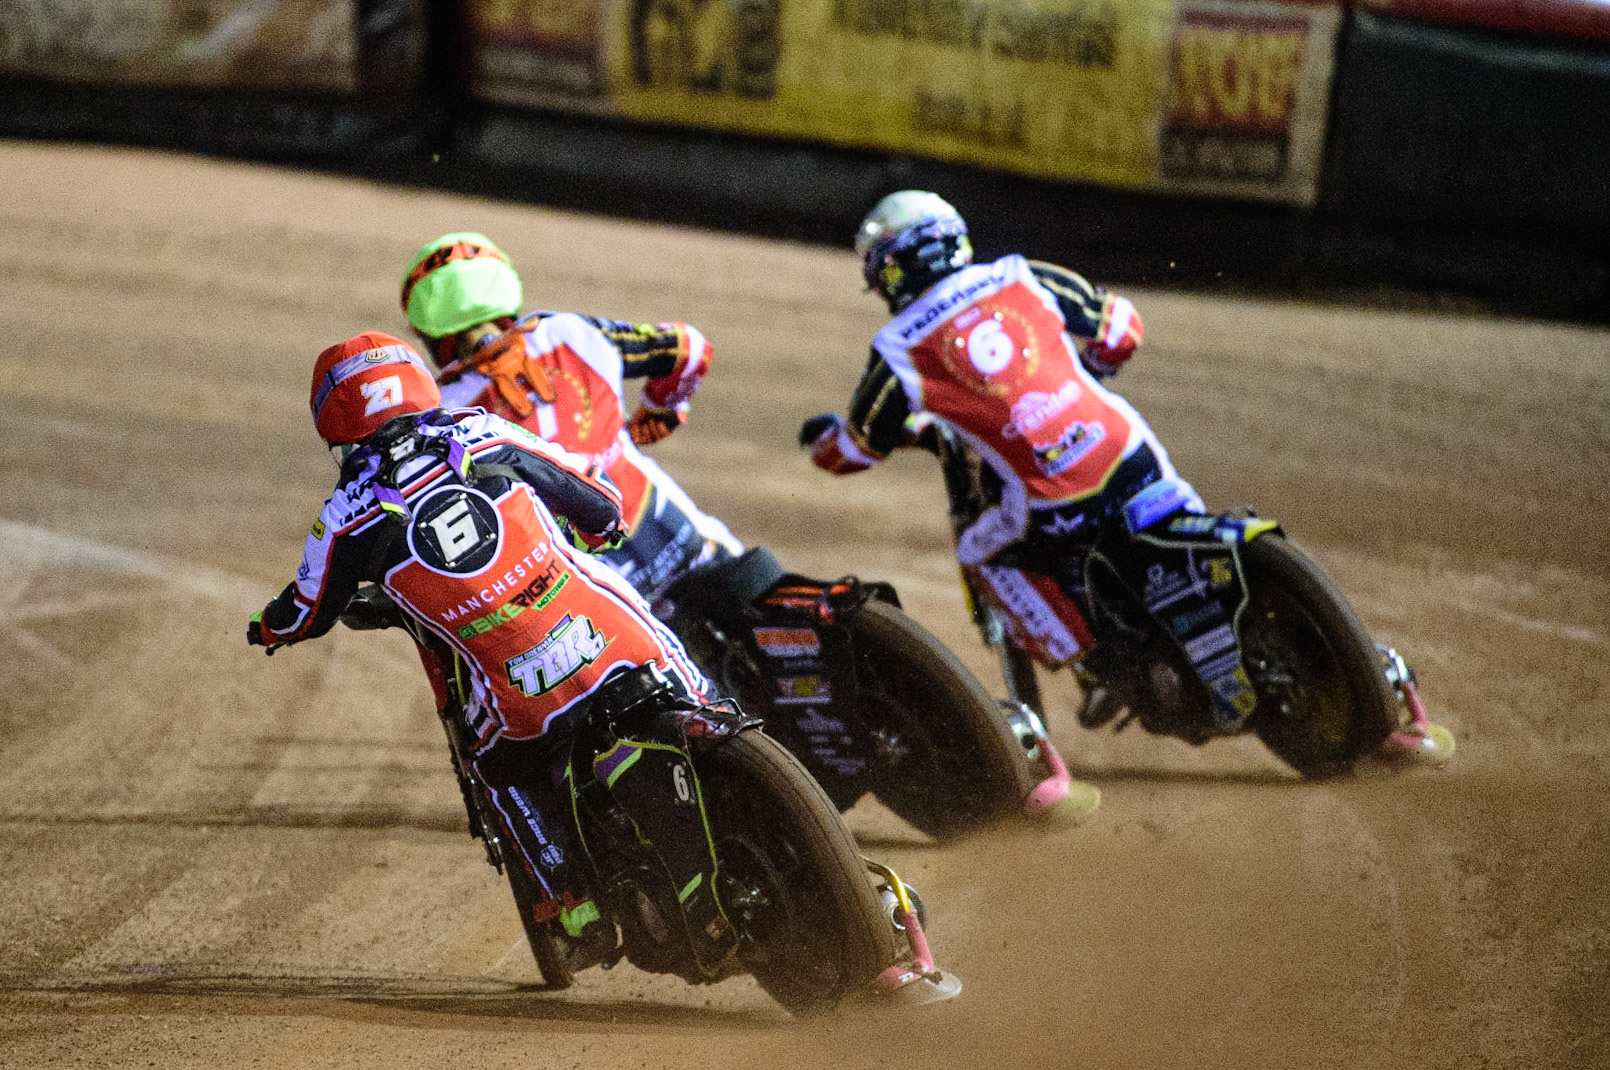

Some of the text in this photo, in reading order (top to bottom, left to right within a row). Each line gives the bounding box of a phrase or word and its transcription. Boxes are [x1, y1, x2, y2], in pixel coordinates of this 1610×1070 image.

[967, 318, 1014, 376] 6
[360, 375, 403, 417] 27
[428, 499, 480, 562] 6
[441, 541, 550, 622] MANCHESTER
[673, 764, 690, 801] 6
